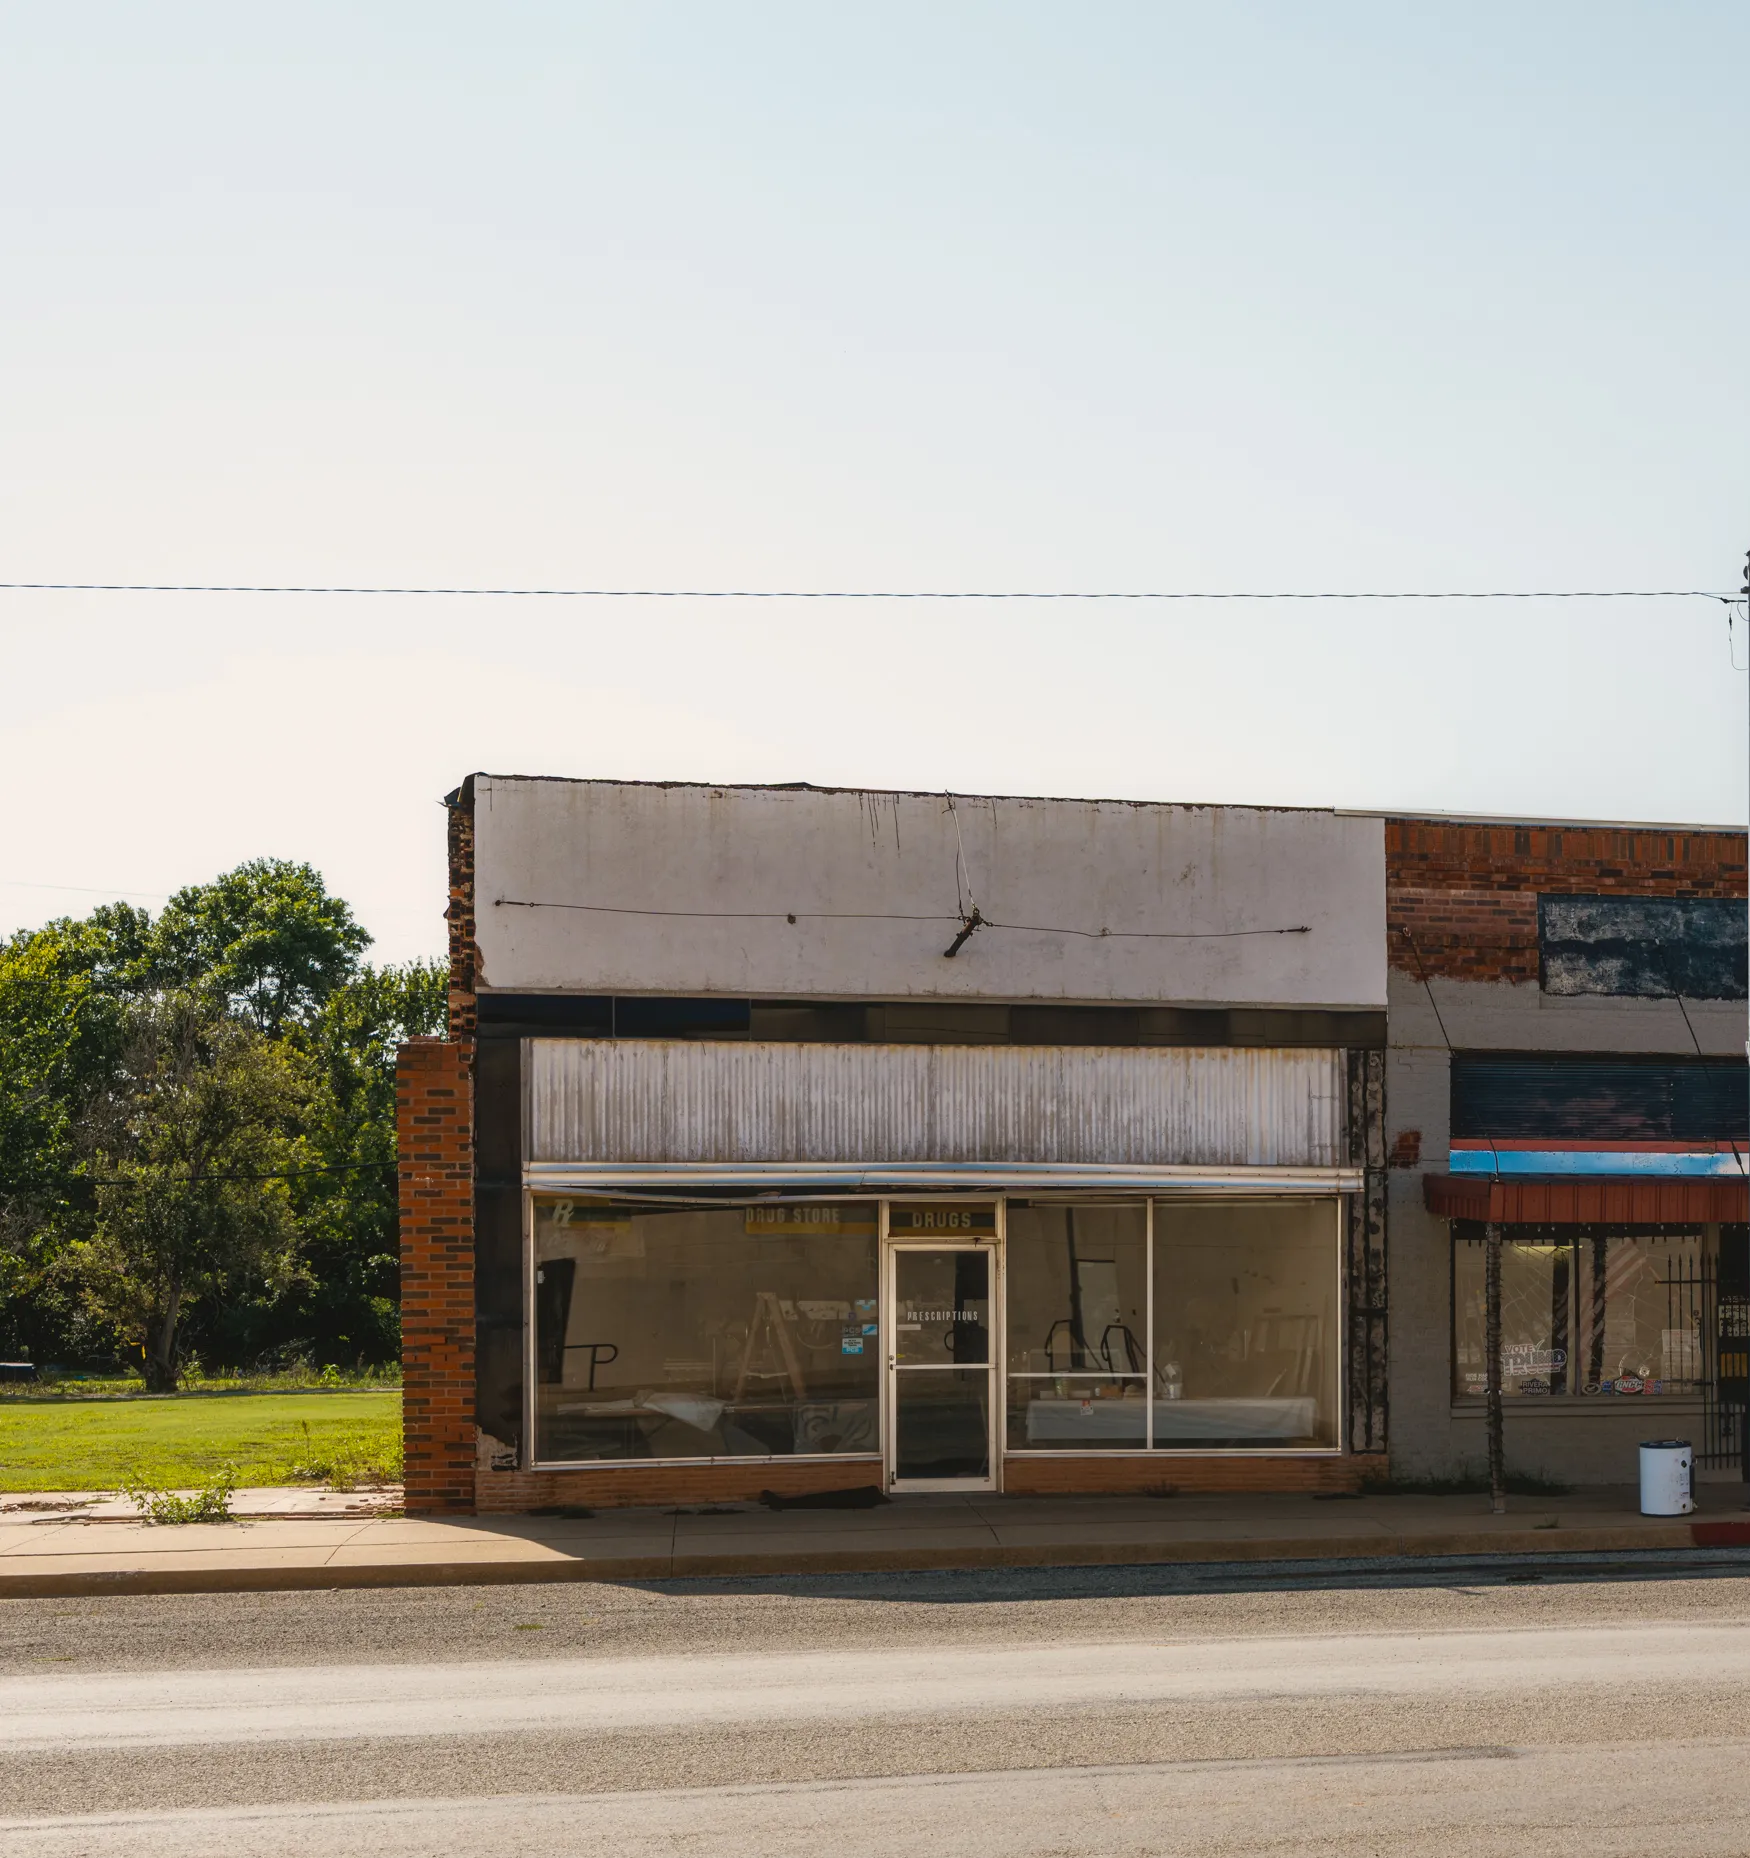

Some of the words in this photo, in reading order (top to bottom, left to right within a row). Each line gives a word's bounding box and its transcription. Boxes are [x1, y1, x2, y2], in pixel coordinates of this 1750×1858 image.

[745, 1207, 786, 1223] DRUG
[792, 1207, 840, 1223] STORE
[912, 1211, 972, 1228] DRUGS
[907, 1310, 978, 1321] PRESCRIPTIONS
[1504, 1343, 1534, 1354] VOTE
[1501, 1348, 1567, 1377] TRUMP
[1521, 1380, 1549, 1388] RIVERA
